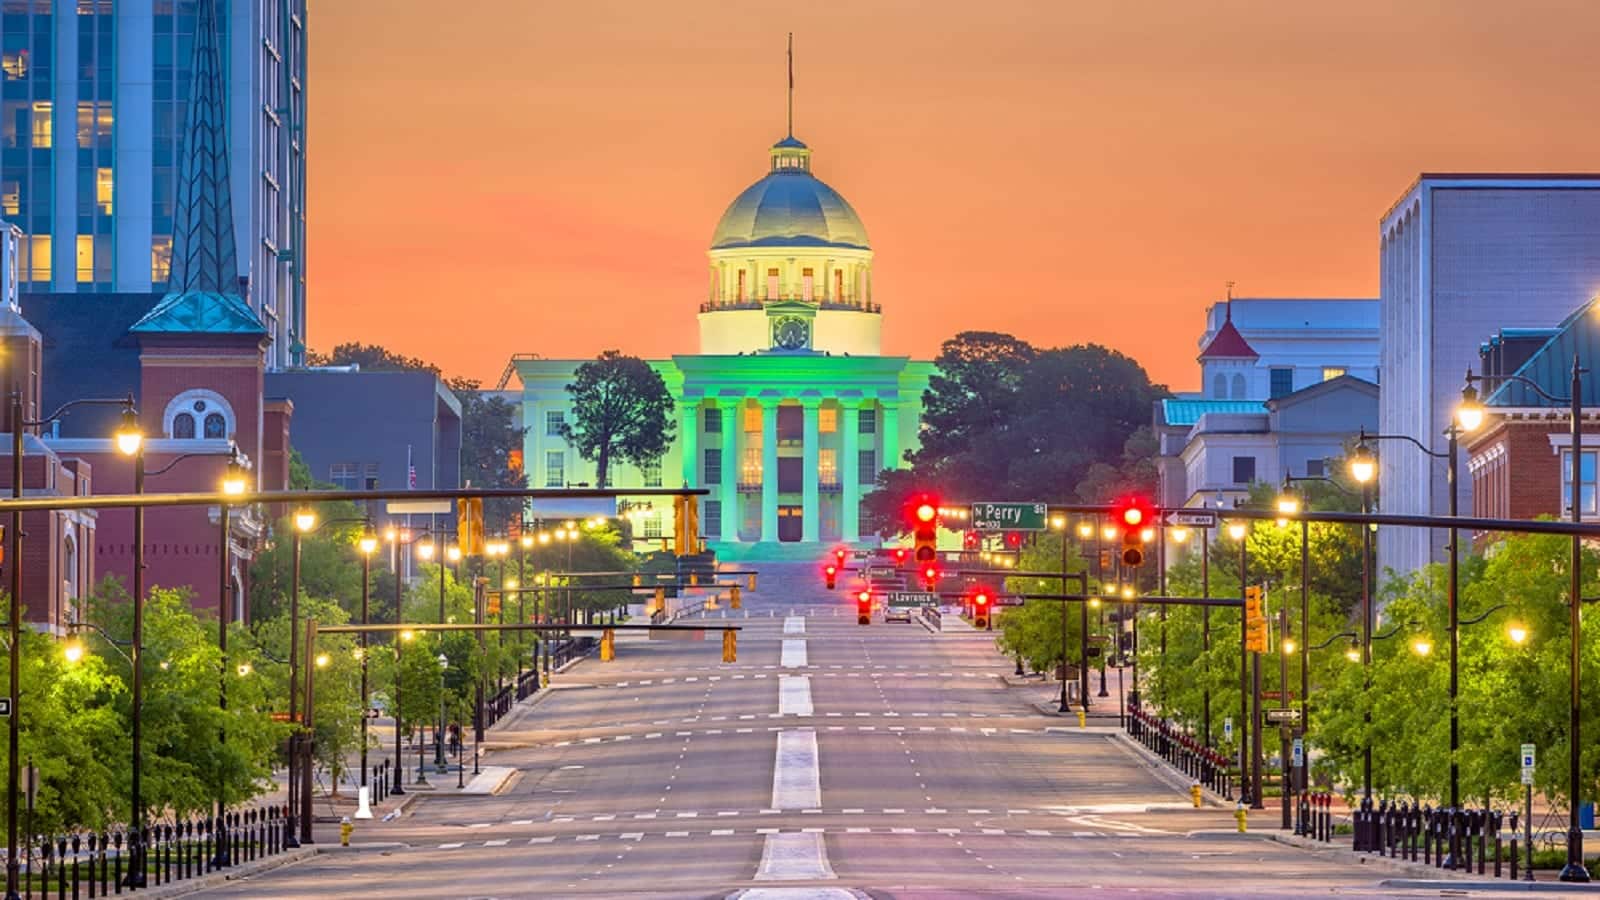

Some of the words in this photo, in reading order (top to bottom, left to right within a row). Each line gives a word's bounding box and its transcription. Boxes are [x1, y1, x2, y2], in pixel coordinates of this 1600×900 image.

[975, 507, 982, 517] N
[986, 504, 1021, 523] Perry
[896, 592, 931, 601] Lawrence
